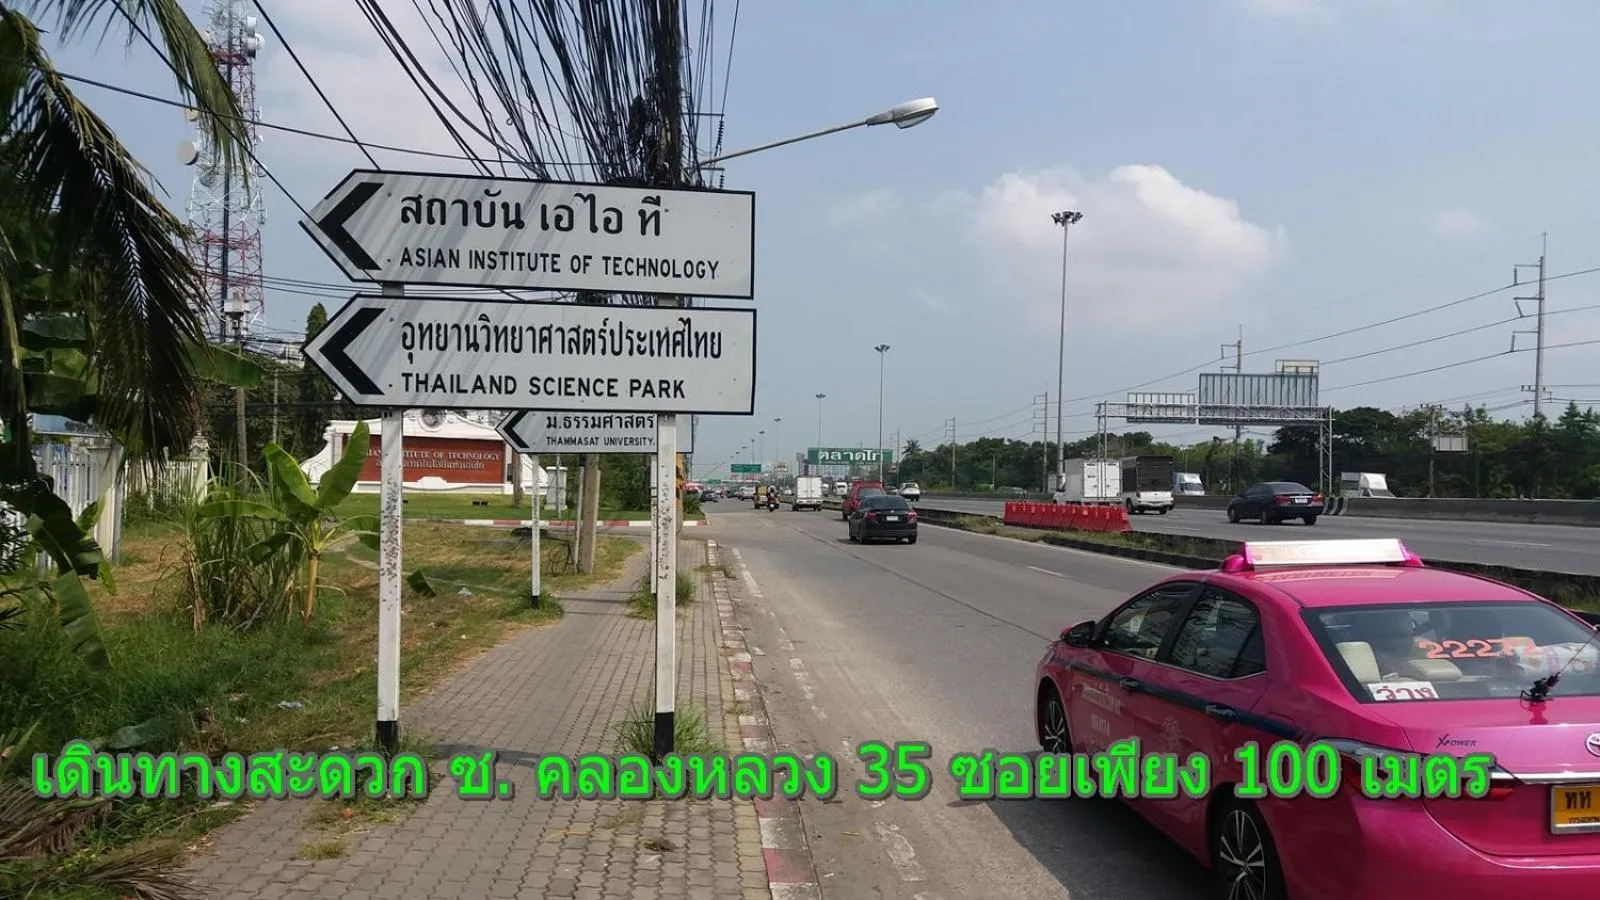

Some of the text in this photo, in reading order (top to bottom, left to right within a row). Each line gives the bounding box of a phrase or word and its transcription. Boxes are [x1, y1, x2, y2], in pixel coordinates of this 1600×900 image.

[400, 188, 526, 231] สถาบัน
[637, 195, 662, 238] ที
[399, 246, 719, 280] ASIAN INSTITUTE OF TECHNOLOGY
[401, 313, 722, 365] อุทยานวิทยาศาสตร์ประเทศไทย
[401, 372, 685, 399] THAILAND SCIENCE PARK
[545, 436, 600, 446] THAMMASAT
[447, 452, 500, 461] TECHNOLOGY
